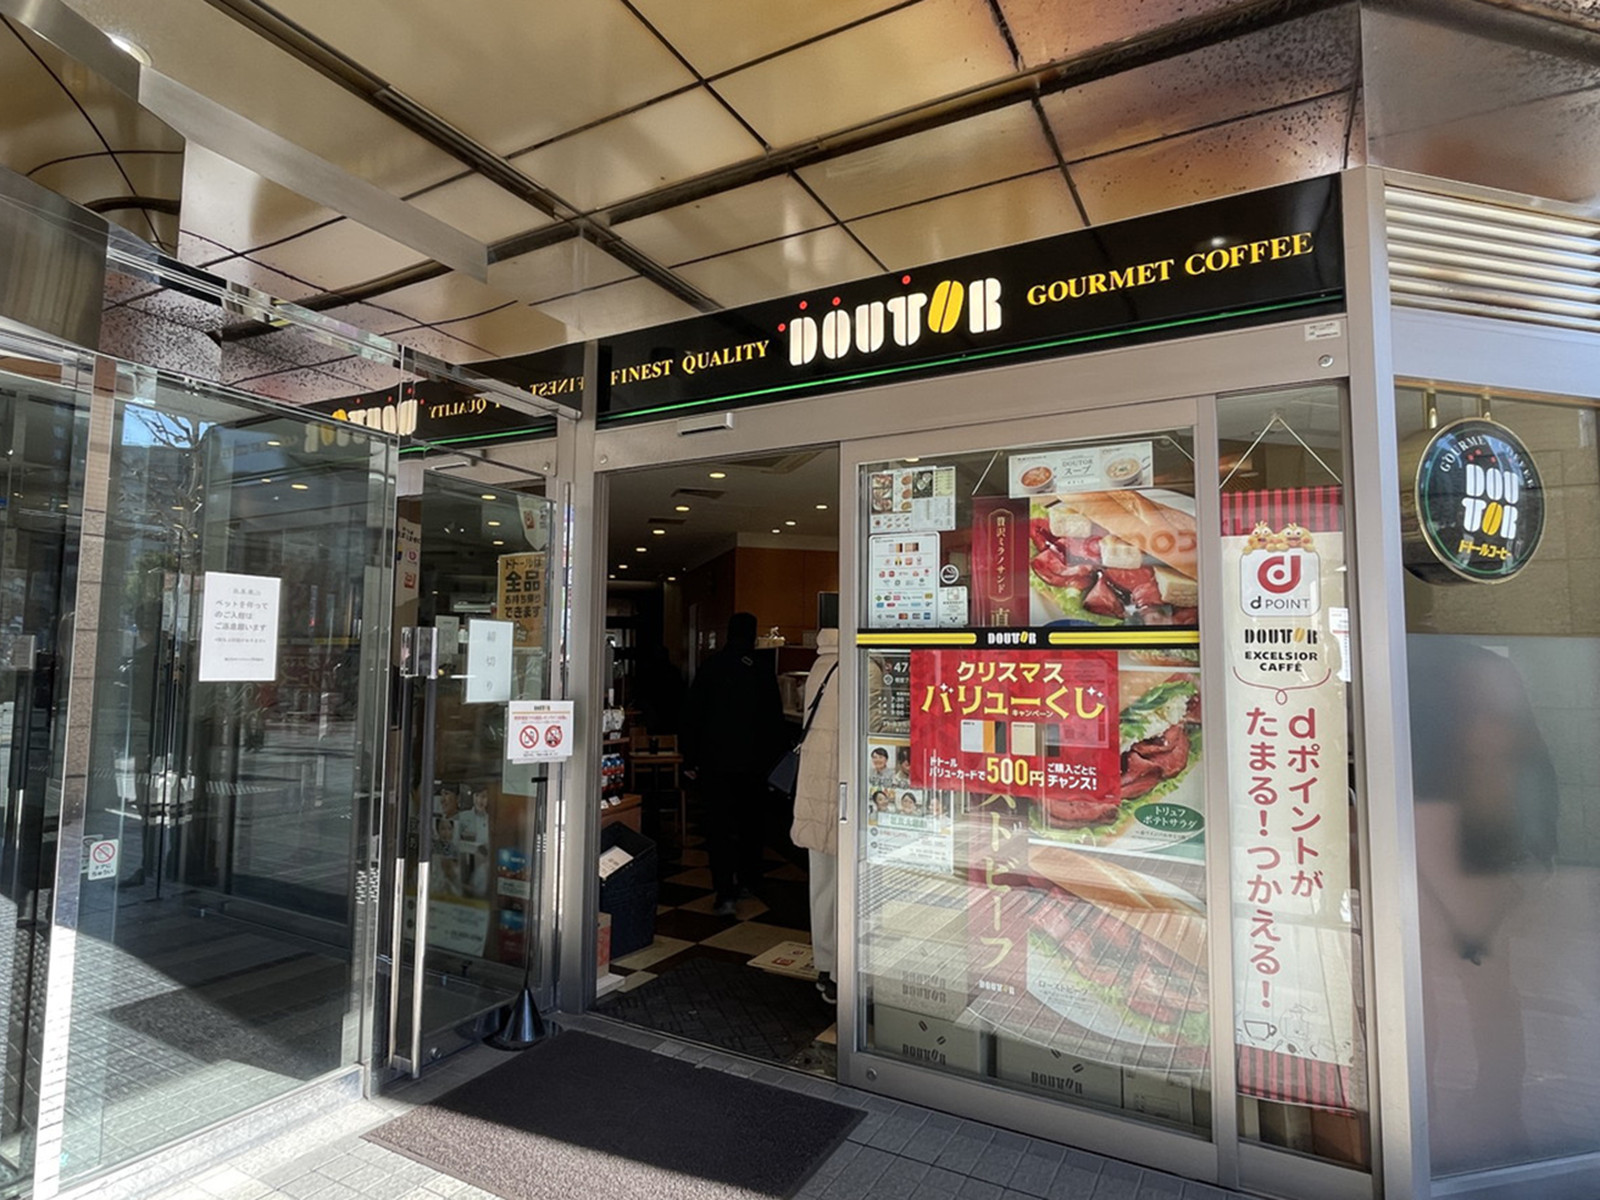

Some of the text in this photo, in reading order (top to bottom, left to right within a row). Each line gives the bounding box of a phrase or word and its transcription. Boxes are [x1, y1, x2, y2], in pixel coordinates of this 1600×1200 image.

[1027, 231, 1313, 305] GOURMET COFFEE
[788, 277, 1002, 366] DOUTOR
[611, 340, 769, 387] FINEST QUALITY
[1064, 465, 1092, 476] スープ
[1466, 463, 1519, 504] DOU
[1461, 497, 1518, 540] TOR
[505, 570, 540, 593] 全品
[1265, 598, 1310, 609] POINT
[505, 606, 541, 618] できます
[987, 631, 1037, 645] DOUTOR
[1244, 627, 1318, 644] DOUTOR
[1244, 651, 1318, 661] EXCELSIOR
[957, 661, 1064, 684] クリスマス
[1259, 662, 1302, 672] CAFFÉ
[921, 685, 1106, 719] バリューくじ
[1011, 709, 1054, 718] キャンペーン
[929, 756, 958, 767] ドトール
[1047, 763, 1097, 776] ご購入ごとに
[929, 756, 1045, 787] バリューカードで 500円
[1047, 774, 1097, 790] チャンス！
[1287, 707, 1323, 898] dポイントが
[1155, 806, 1187, 817] トリュフ
[1143, 815, 1198, 829] ポテトサラダ
[1246, 706, 1283, 1009] たまる！つかえる！
